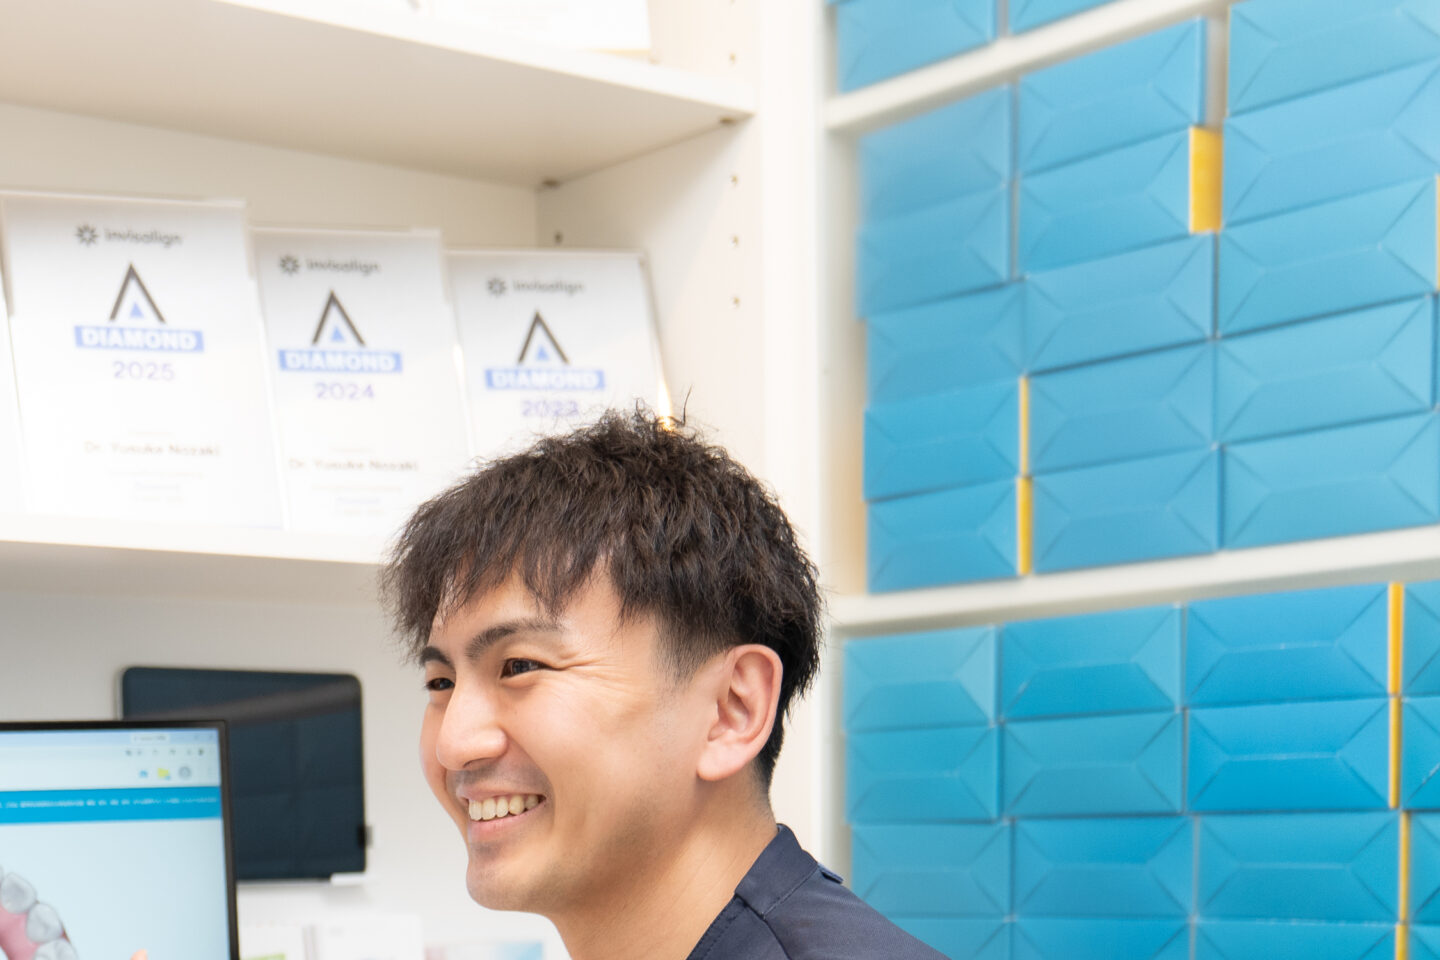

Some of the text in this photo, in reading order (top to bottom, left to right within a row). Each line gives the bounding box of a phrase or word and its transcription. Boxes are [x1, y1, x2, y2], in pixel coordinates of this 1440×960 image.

[105, 229, 182, 248] invisalign
[82, 327, 198, 352] DIAMOND
[112, 361, 176, 382] 2025
[285, 351, 396, 372] DIAMOND
[492, 371, 598, 390] DIAMOND
[314, 383, 375, 400] 2024
